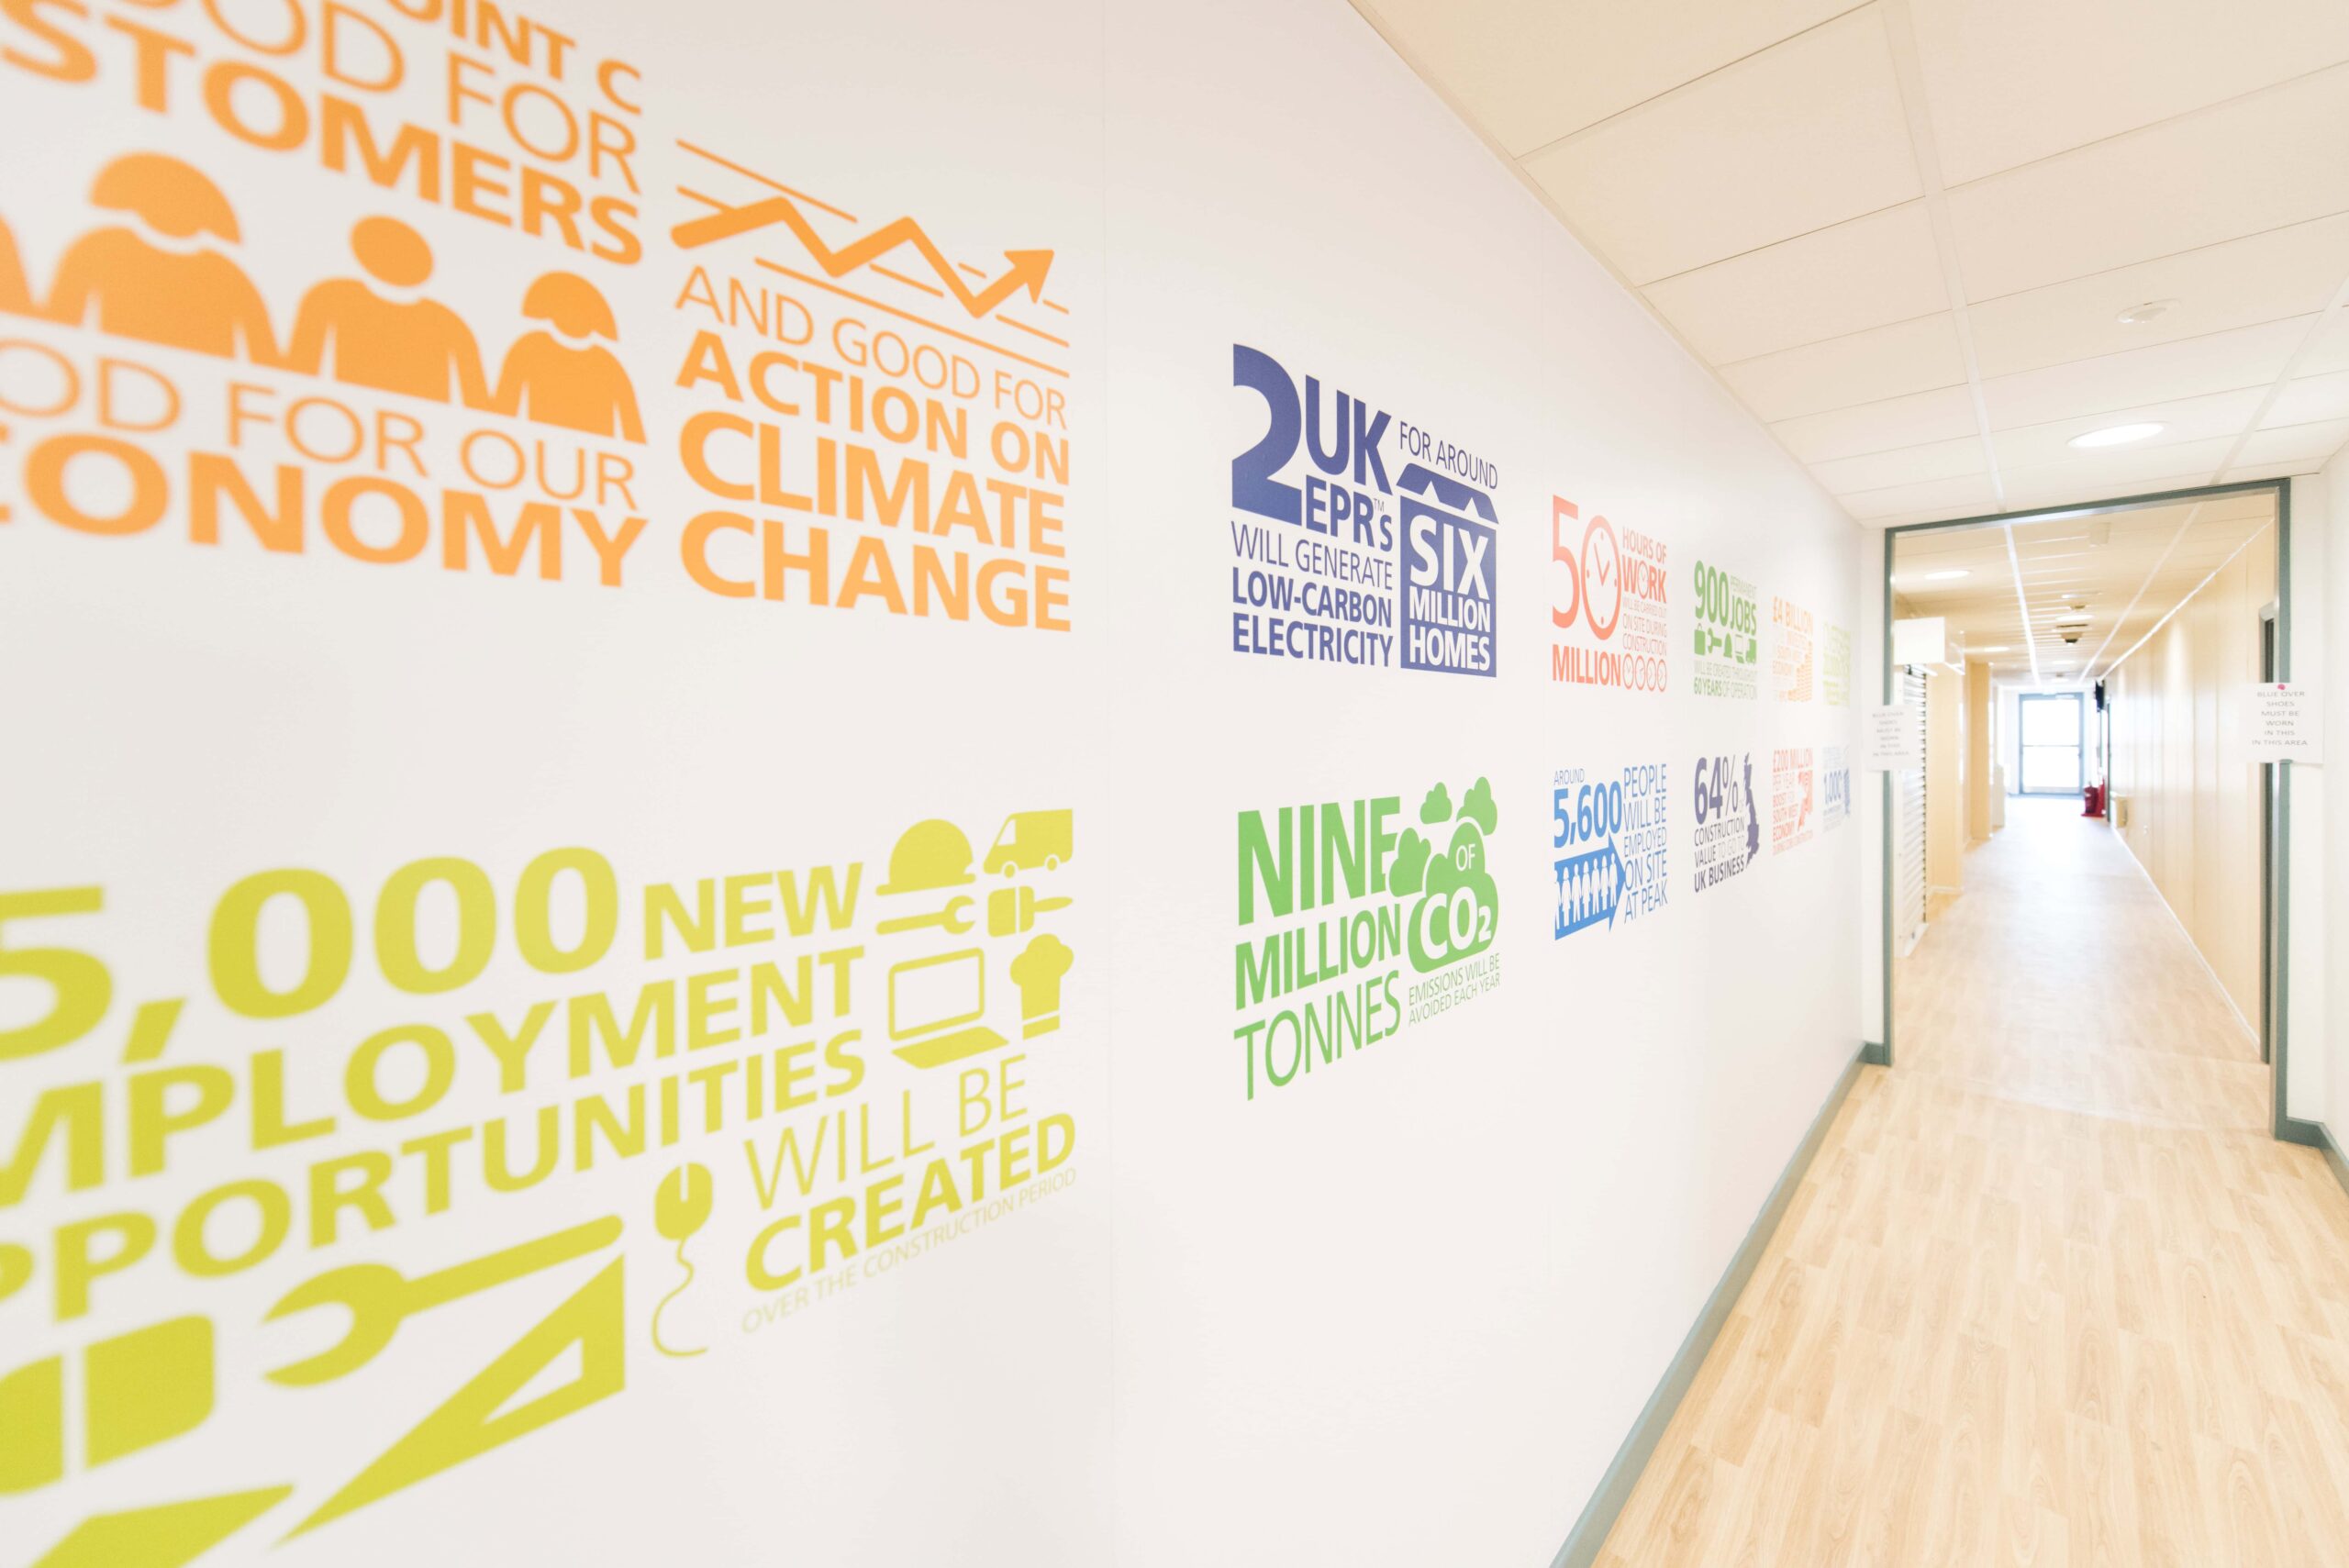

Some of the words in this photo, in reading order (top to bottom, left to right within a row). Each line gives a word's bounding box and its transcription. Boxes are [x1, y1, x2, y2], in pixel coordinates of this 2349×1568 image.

[596, 60, 641, 116] C
[447, 50, 641, 195] FOR
[674, 264, 815, 347] AND
[831, 317, 982, 400] GOOD
[994, 369, 1068, 430] FOR
[674, 328, 969, 461] ACTION
[989, 420, 1070, 486] ON
[1305, 373, 1393, 496] UK
[227, 381, 429, 479] FOR
[460, 428, 639, 512] OUR
[1399, 420, 1432, 463] FOR
[1436, 439, 1498, 490] AROUND
[0, 420, 649, 587] ONOMY
[678, 409, 1066, 559] CLIMATE
[679, 510, 1072, 633] CHANGE
[1230, 520, 1288, 568] WILL
[1295, 539, 1393, 591] GENERATE
[1408, 514, 1491, 601] SIX
[1621, 526, 1654, 561] HOURS
[1655, 541, 1666, 565] OF
[1232, 566, 1392, 628] LOW-CARBON
[1621, 554, 1667, 605] WORK
[1694, 560, 1730, 627] 900
[1408, 585, 1491, 633] MILLION
[1633, 616, 1645, 633] SITE
[1730, 595, 1757, 636] JOBS
[1232, 612, 1394, 667] ELECTRICITY
[1408, 624, 1491, 672] HOMES
[1552, 644, 1621, 686] MILLION
[1622, 632, 1667, 656] CONSTRUCTION
[1702, 677, 1722, 697] YEARS
[1553, 768, 1586, 786] AROUND
[1623, 763, 1666, 800] PEOPLE
[1694, 754, 1739, 825] 64%
[1553, 781, 1622, 849] 5,600
[1623, 799, 1652, 832] WILL
[1654, 796, 1666, 824] BE
[1694, 815, 1745, 847] CONSTRUCTION
[1238, 795, 1400, 927] NINE
[1455, 843, 1475, 872] OF
[1623, 827, 1667, 858] EMPLOYED
[1624, 855, 1643, 891] ON
[1645, 849, 1667, 884] SITE
[1694, 845, 1717, 869] VALUE
[1623, 891, 1639, 924] AT
[1641, 879, 1668, 917] PEAK
[1694, 868, 1707, 894] UK
[1709, 854, 1745, 887] BUSINESS
[643, 862, 864, 962] NEW
[1236, 903, 1401, 1012] MILLION
[1408, 967, 1464, 1007] EMISSIONS
[1465, 959, 1487, 982] WILL
[1489, 952, 1500, 973] BE
[1408, 994, 1453, 1028] AVOIDED
[1453, 982, 1477, 1006] EACH
[1479, 973, 1500, 993] YEAR
[1234, 969, 1401, 1101] TONNES
[743, 1088, 936, 1211] WILL
[959, 1052, 1028, 1138] BE
[745, 1112, 1076, 1292] CREATED
[741, 1286, 810, 1334] OVER
[813, 1262, 858, 1302] THE
[863, 1194, 1015, 1279] CONSTRUCTION
[1018, 1167, 1077, 1209] PERIOD
